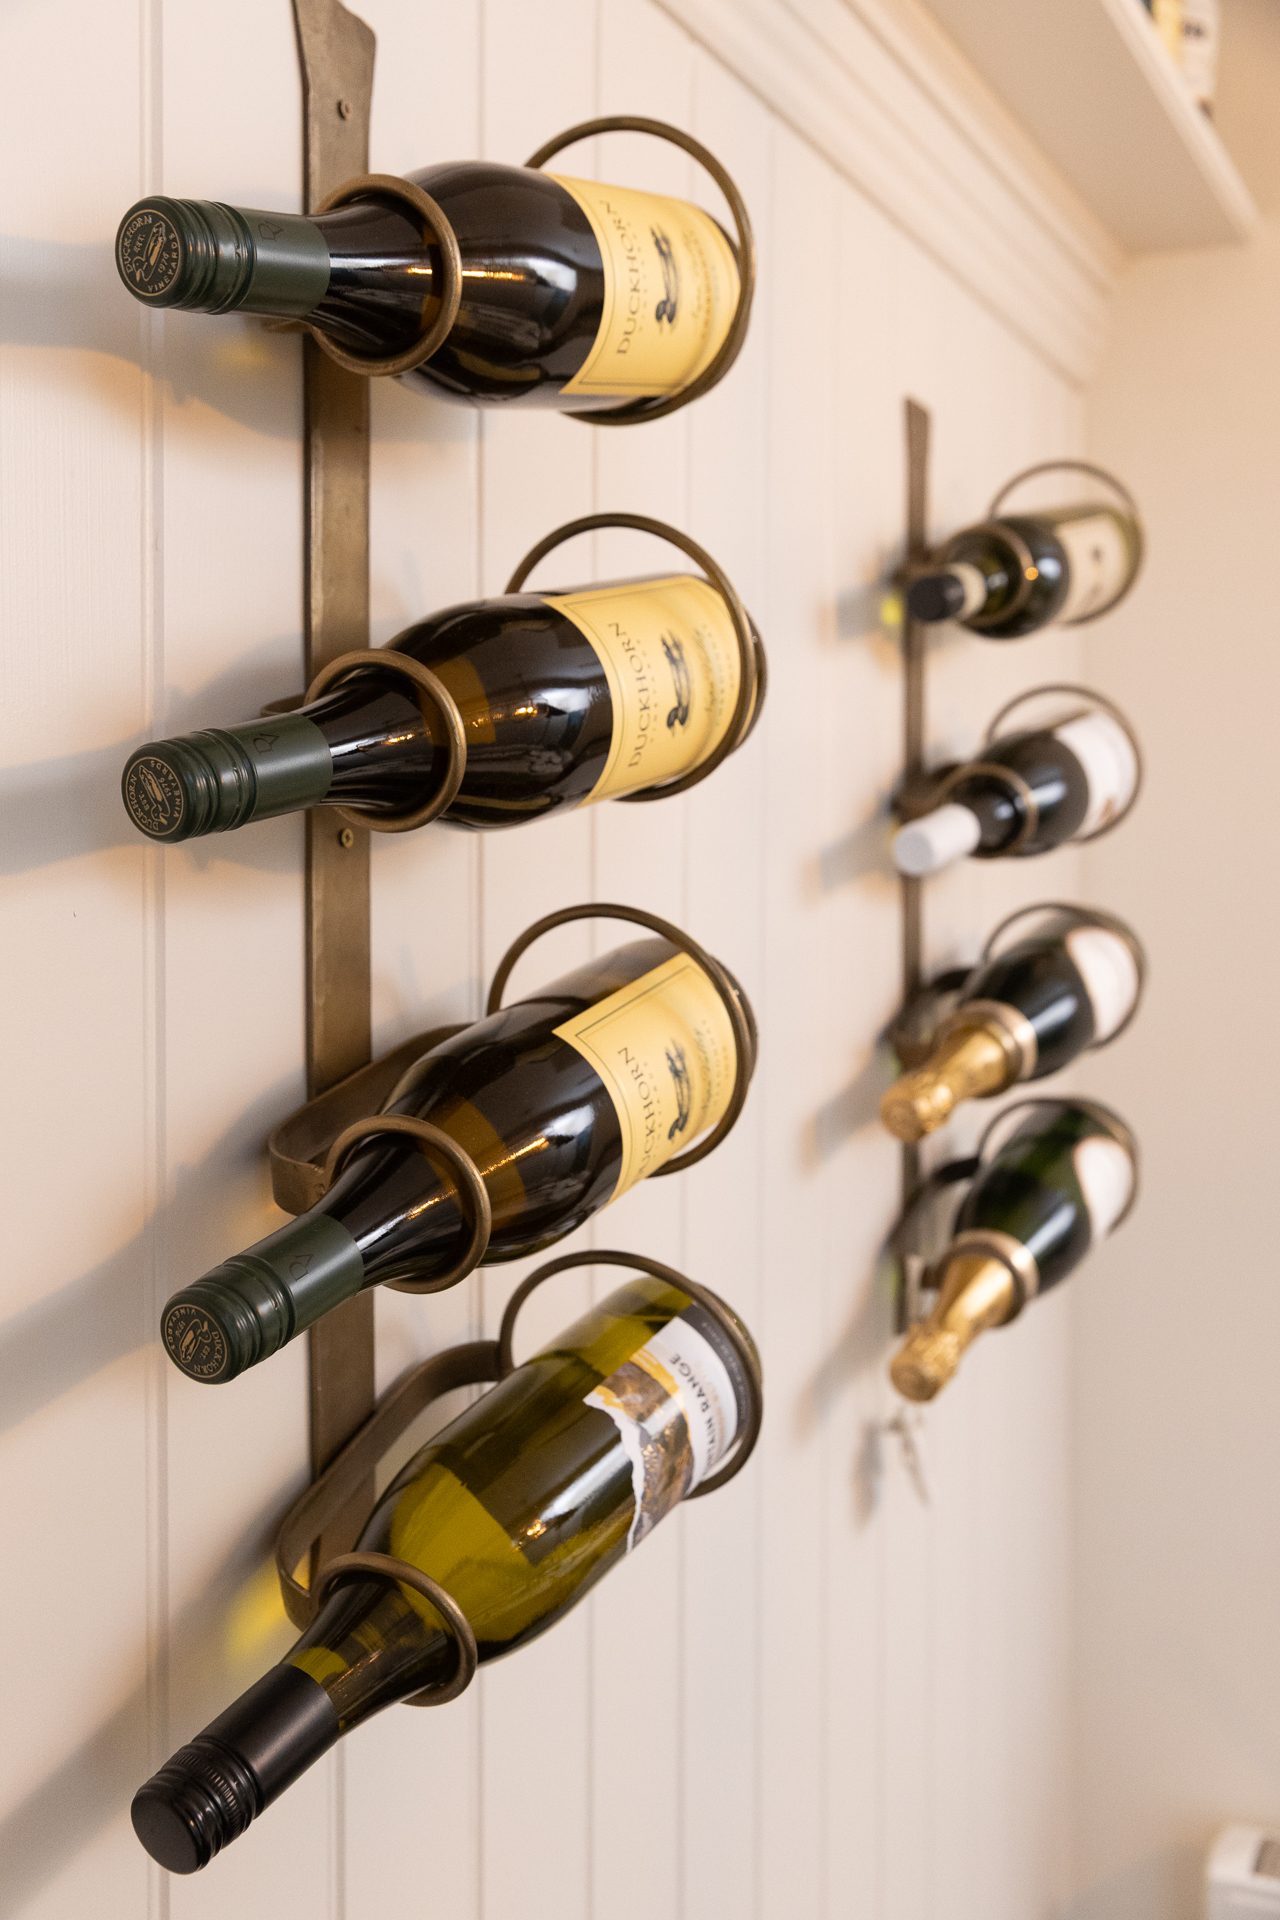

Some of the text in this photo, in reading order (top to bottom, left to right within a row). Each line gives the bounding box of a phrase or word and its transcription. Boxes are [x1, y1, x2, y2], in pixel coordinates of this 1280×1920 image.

[122, 214, 152, 274] DUCKHORN
[147, 232, 178, 292] VINEYARDS
[599, 200, 640, 355] DUCKHORN
[608, 622, 651, 768] DUCKHORN
[127, 773, 160, 831] DUCKHORN
[150, 760, 183, 818] VINEYARDS
[158, 777, 172, 797] 1976
[617, 1047, 655, 1174] UCKHORN
[167, 1308, 197, 1351] VINEYARDS
[193, 1330, 223, 1374] DUCKHORN
[668, 1353, 710, 1413] RANGE
